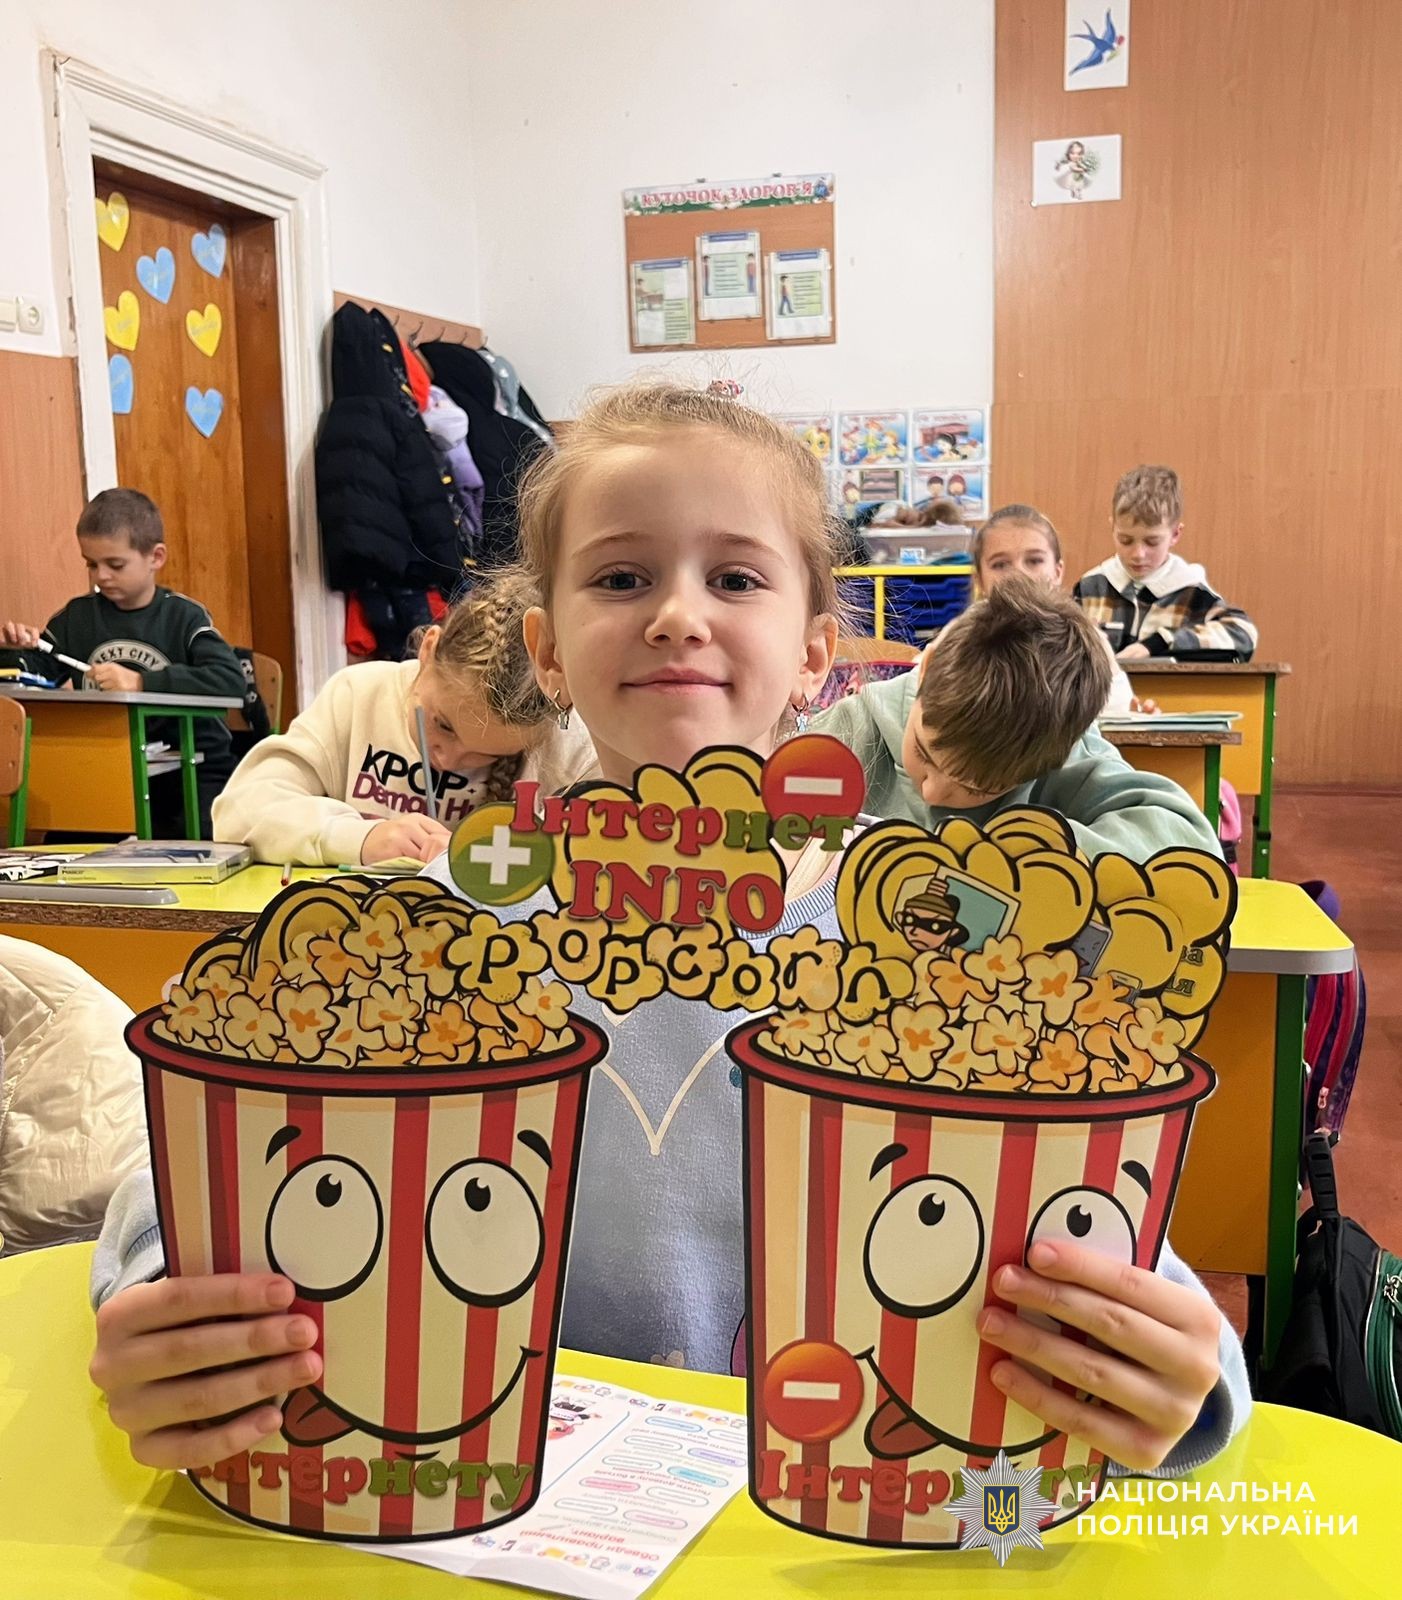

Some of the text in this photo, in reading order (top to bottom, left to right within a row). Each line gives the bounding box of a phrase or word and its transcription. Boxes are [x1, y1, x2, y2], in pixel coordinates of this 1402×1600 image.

[641, 189, 722, 207] КУТОЧОК
[95, 646, 158, 667] EXT CITY
[361, 743, 469, 800] KPOP
[511, 780, 855, 857] Інтернет
[568, 860, 785, 932] INFO
[196, 1448, 534, 1511] нтернету
[757, 1449, 1102, 1515] Інтерту
